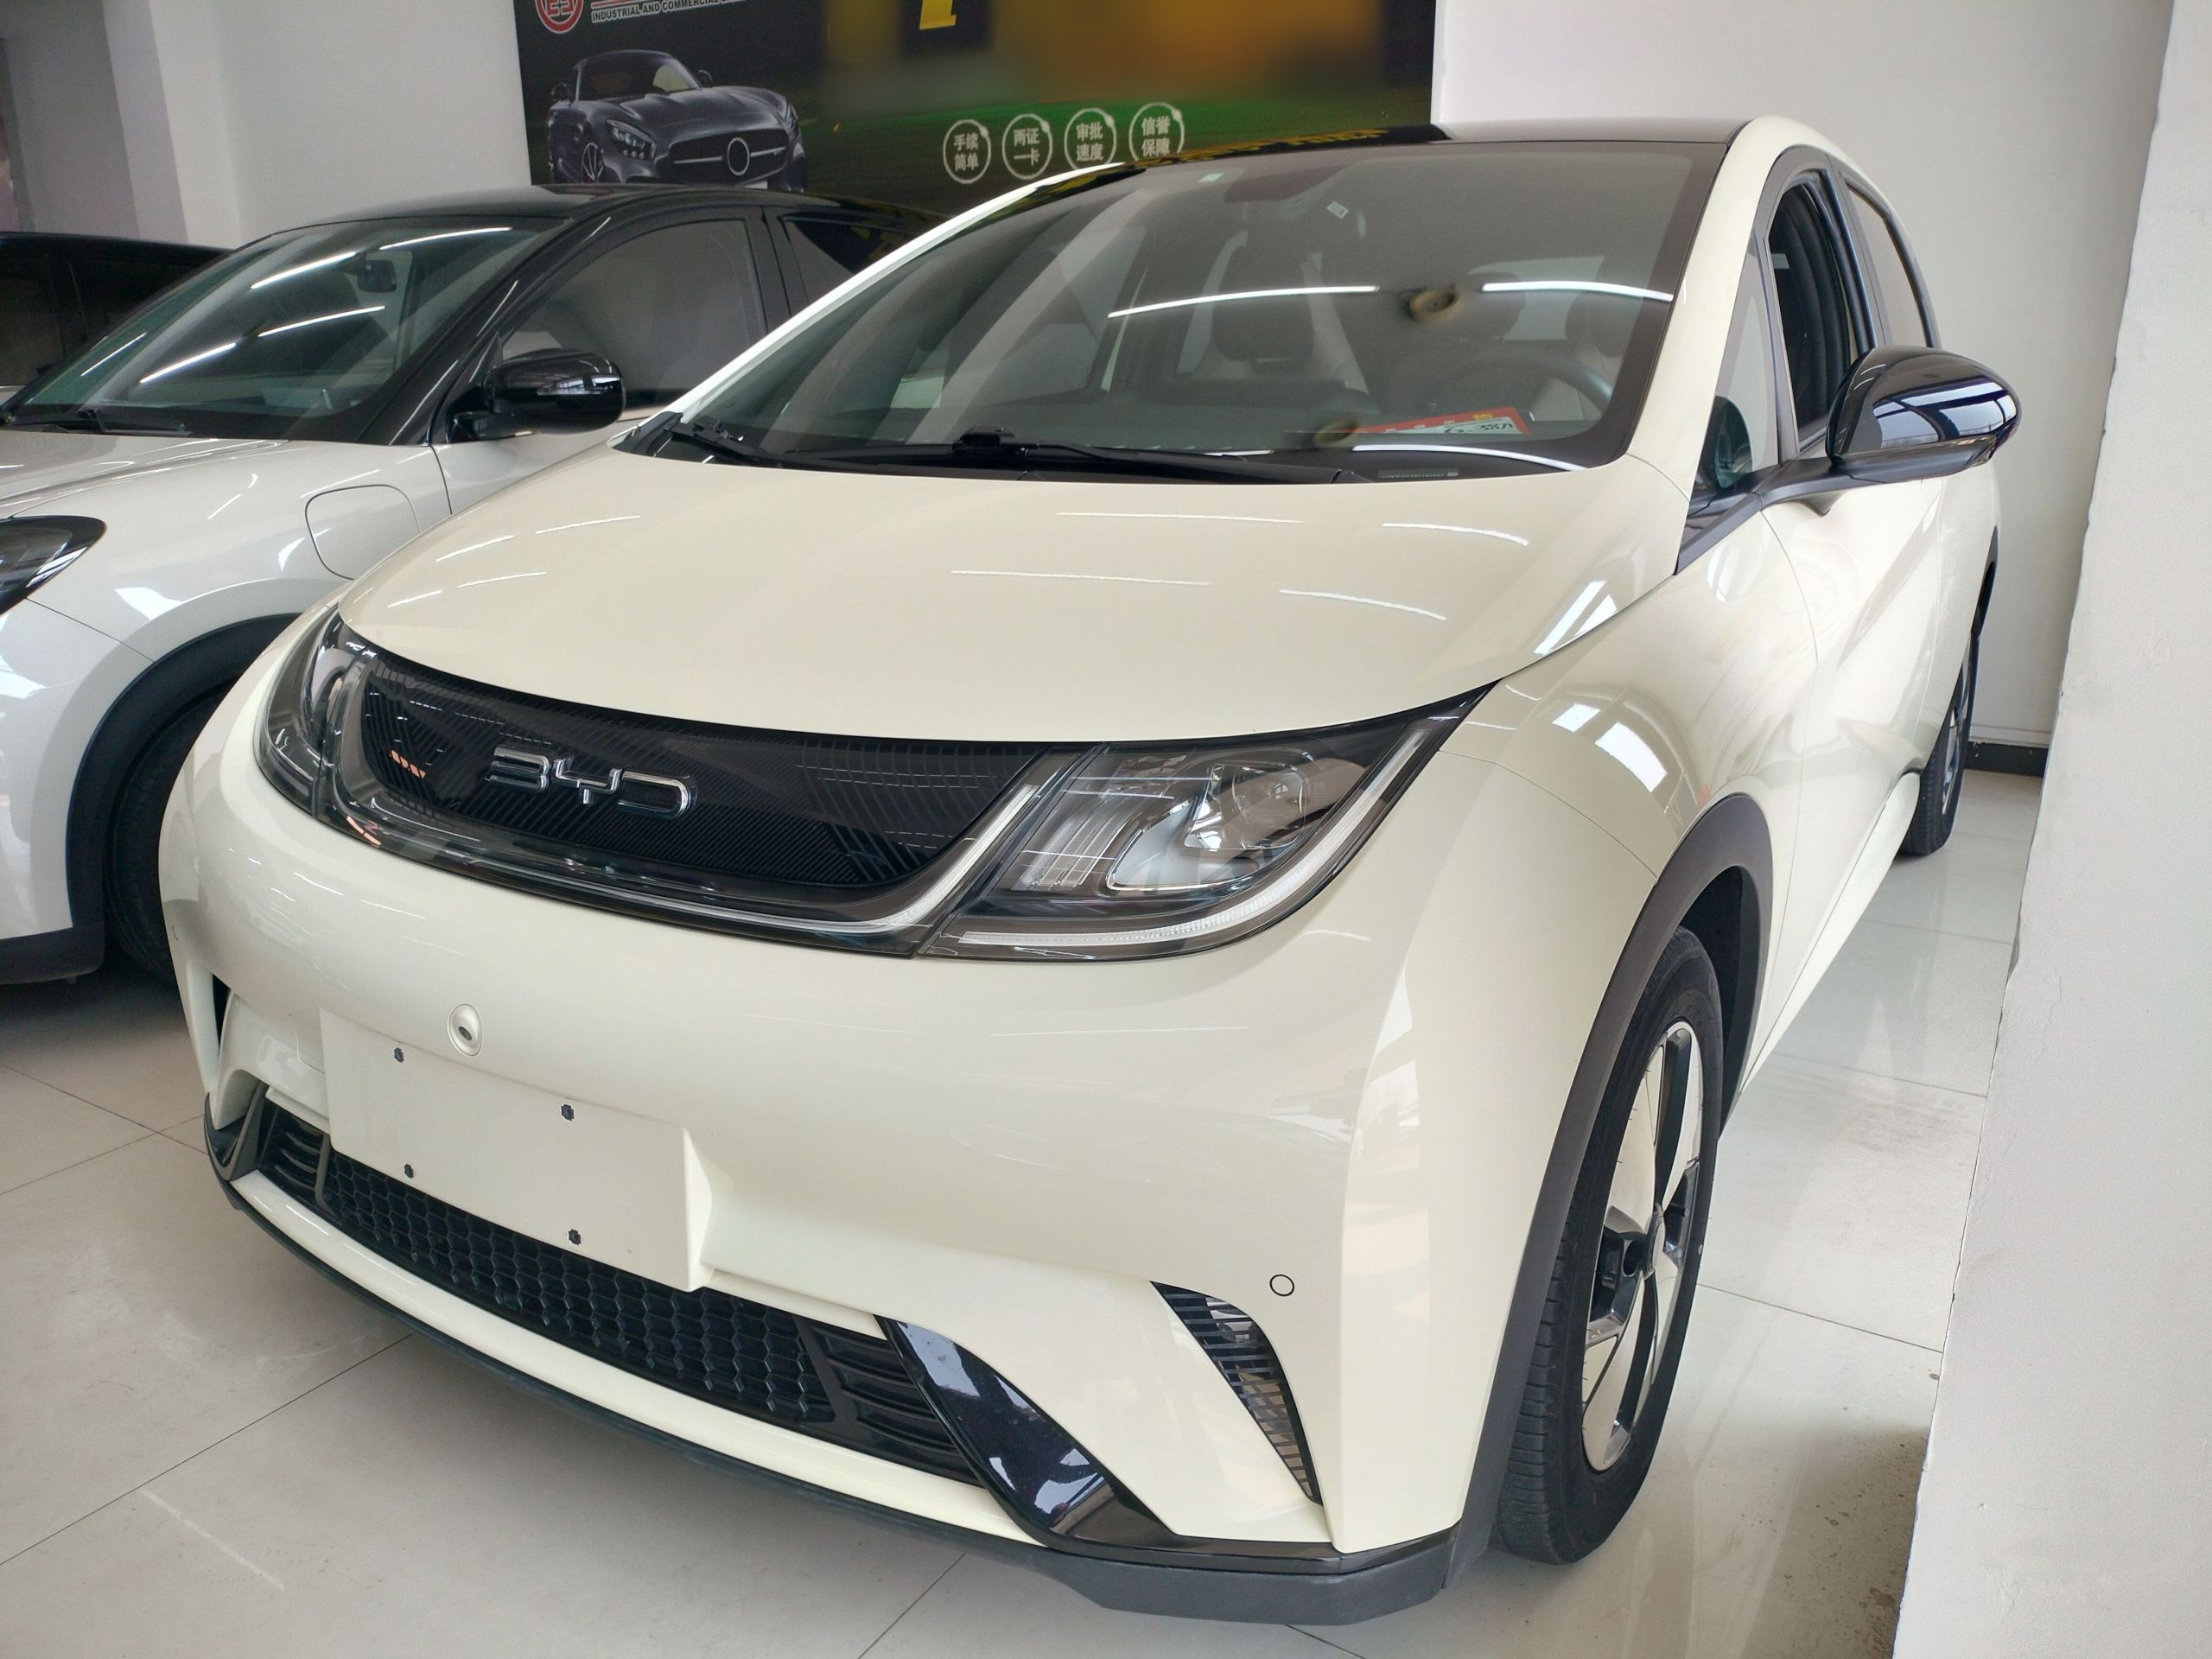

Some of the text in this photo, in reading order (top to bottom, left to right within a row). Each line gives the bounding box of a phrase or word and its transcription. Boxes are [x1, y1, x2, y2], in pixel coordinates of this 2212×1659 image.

[592, 0, 719, 22] INDUSTRIAL AND COMMERC
[1076, 122, 1103, 142] 审批
[1141, 115, 1170, 137] 信誉
[954, 132, 978, 151] 手续
[1014, 127, 1039, 147] 两证
[1141, 137, 1170, 157] 保障
[954, 152, 979, 172] 简单
[1014, 147, 1039, 166] 一卡
[1077, 143, 1103, 162] 速度
[488, 743, 697, 820] BYD
